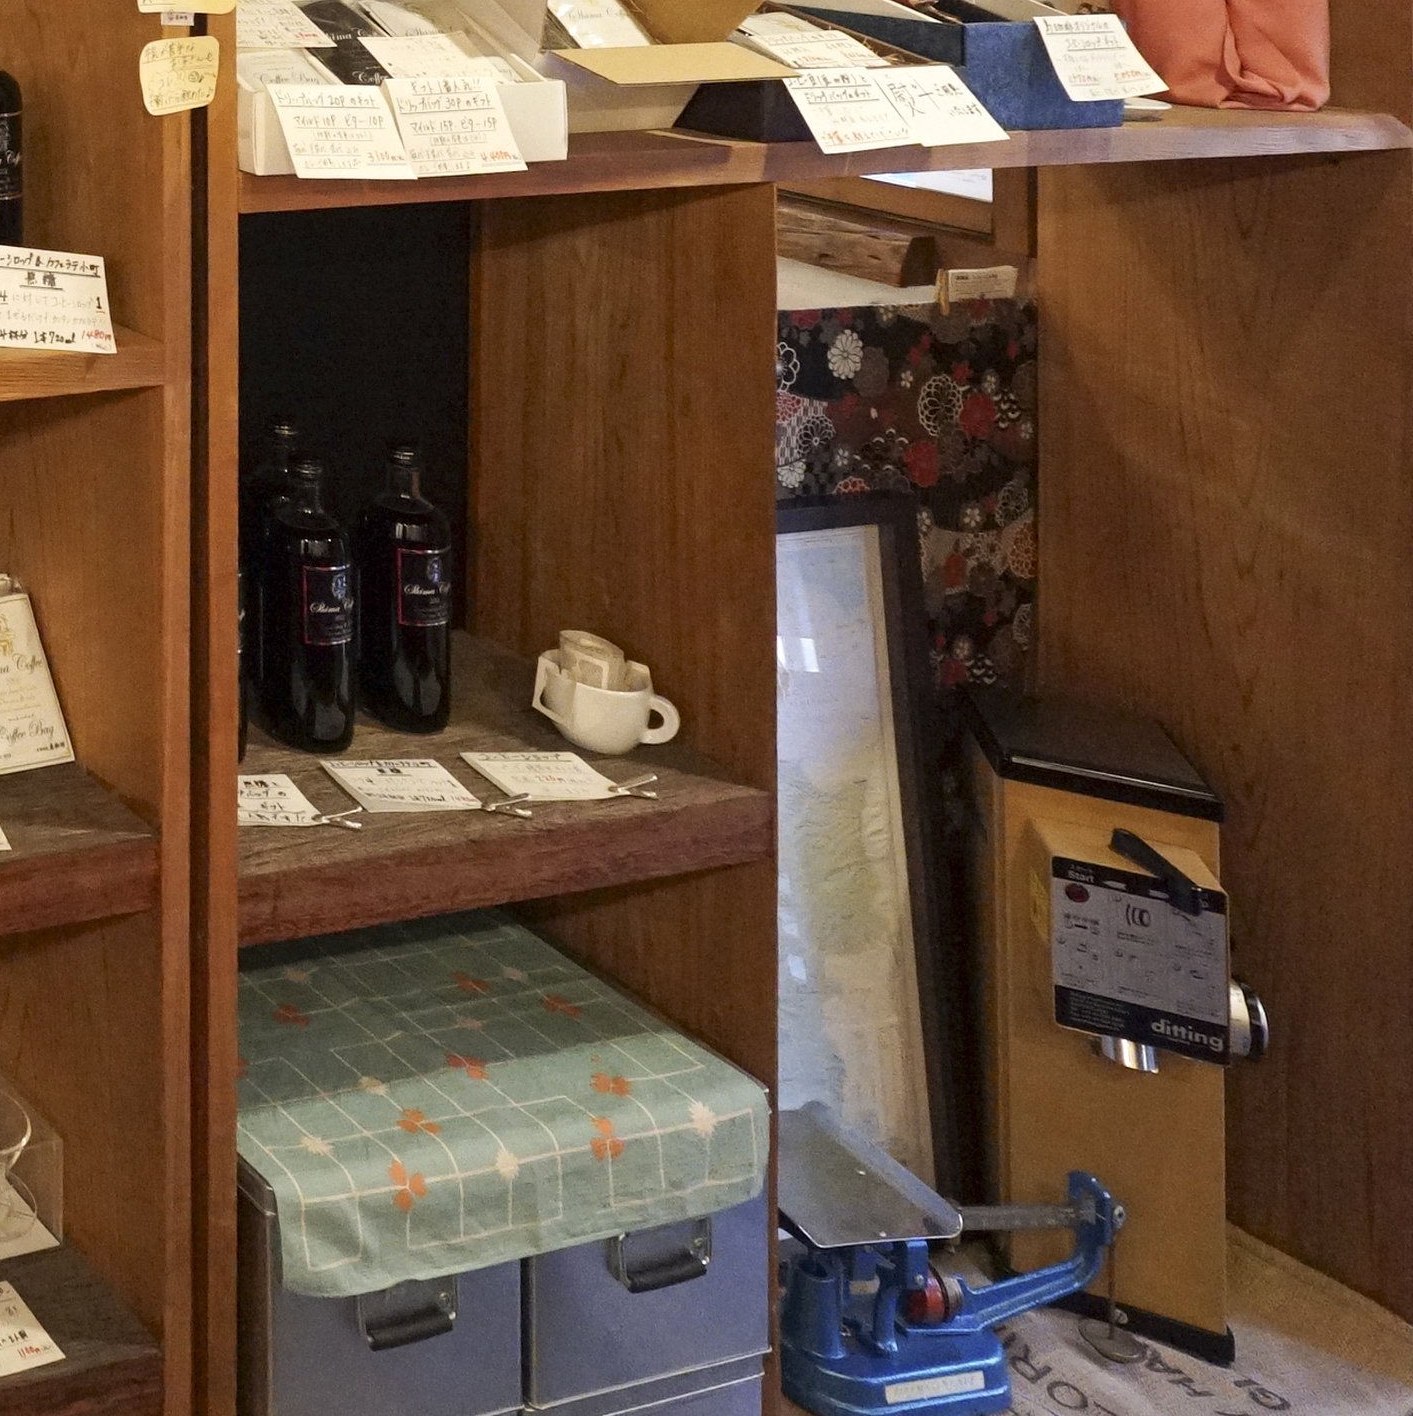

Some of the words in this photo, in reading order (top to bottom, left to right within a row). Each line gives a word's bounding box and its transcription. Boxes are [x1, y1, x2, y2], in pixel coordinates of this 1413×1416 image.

[12, 653, 42, 674] Coffee
[29, 719, 54, 740] Bag
[1151, 1019, 1223, 1051] ditting
